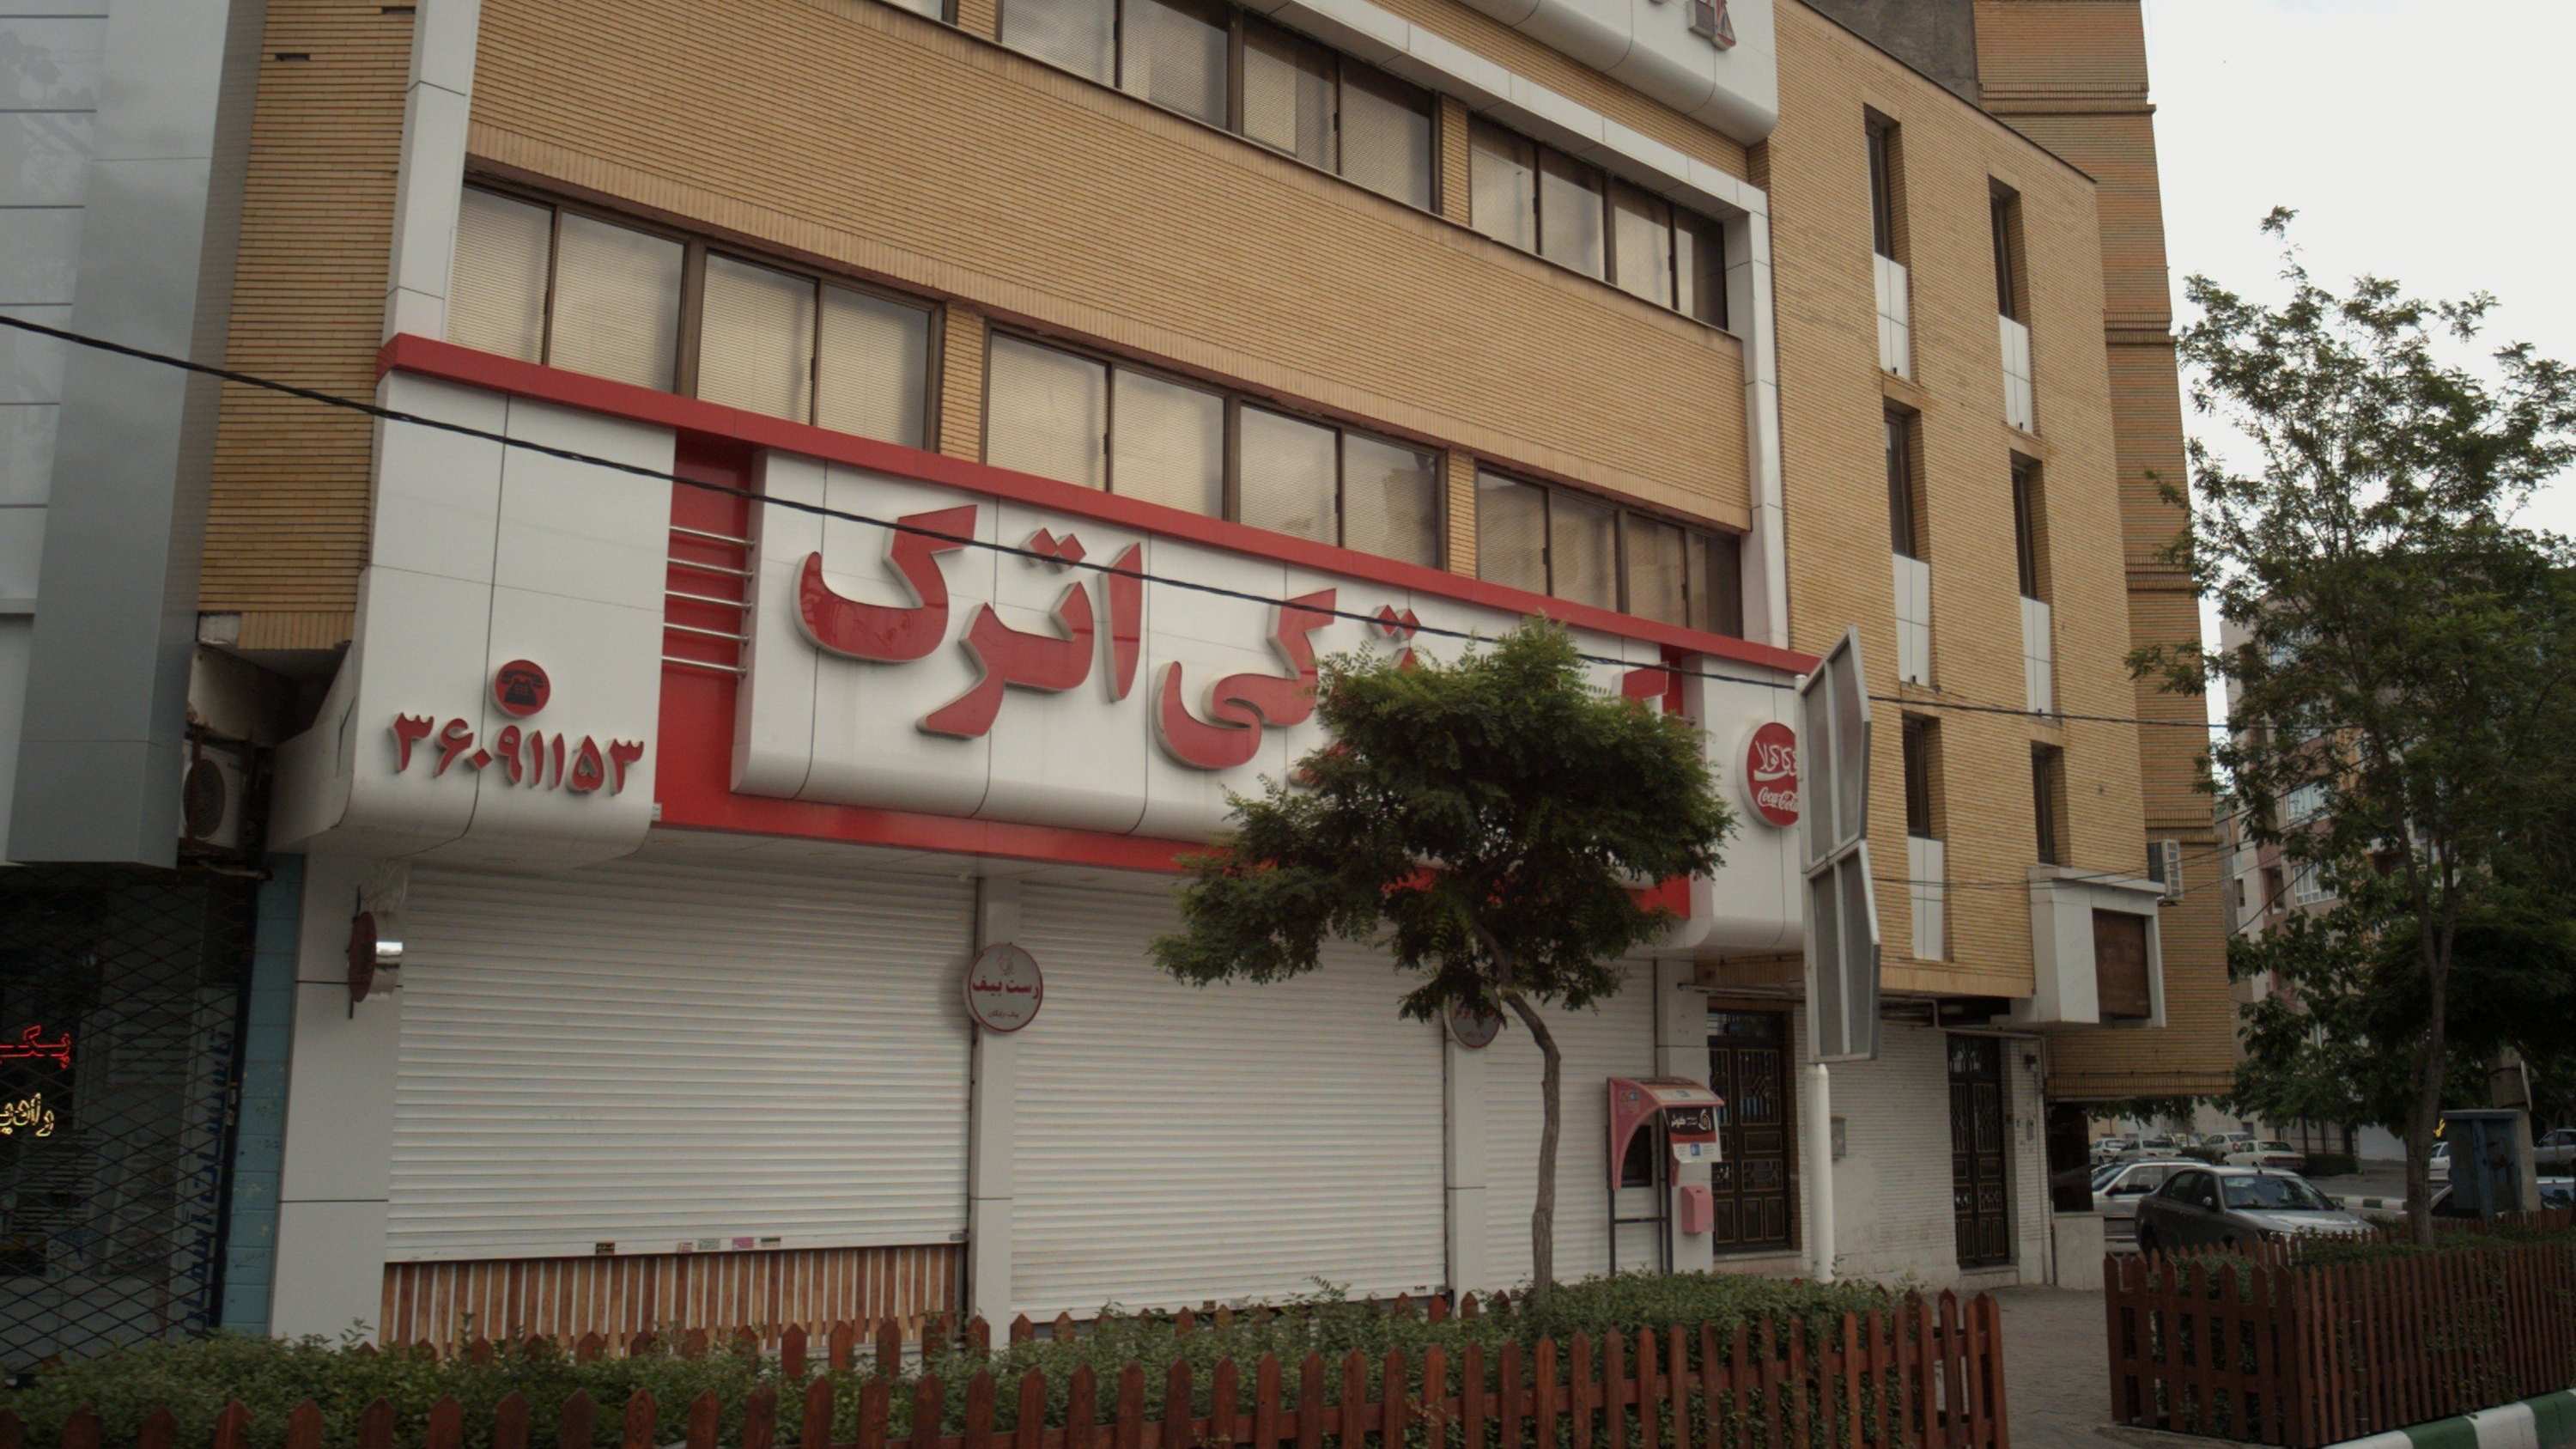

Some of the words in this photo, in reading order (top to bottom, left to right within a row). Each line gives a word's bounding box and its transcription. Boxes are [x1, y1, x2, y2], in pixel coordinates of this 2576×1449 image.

[792, 504, 1142, 739] اترک
[389, 712, 644, 795] ۳۶۰۹۱۱۵۳
[972, 975, 1002, 997] بیف
[1005, 979, 1039, 1000] رست
